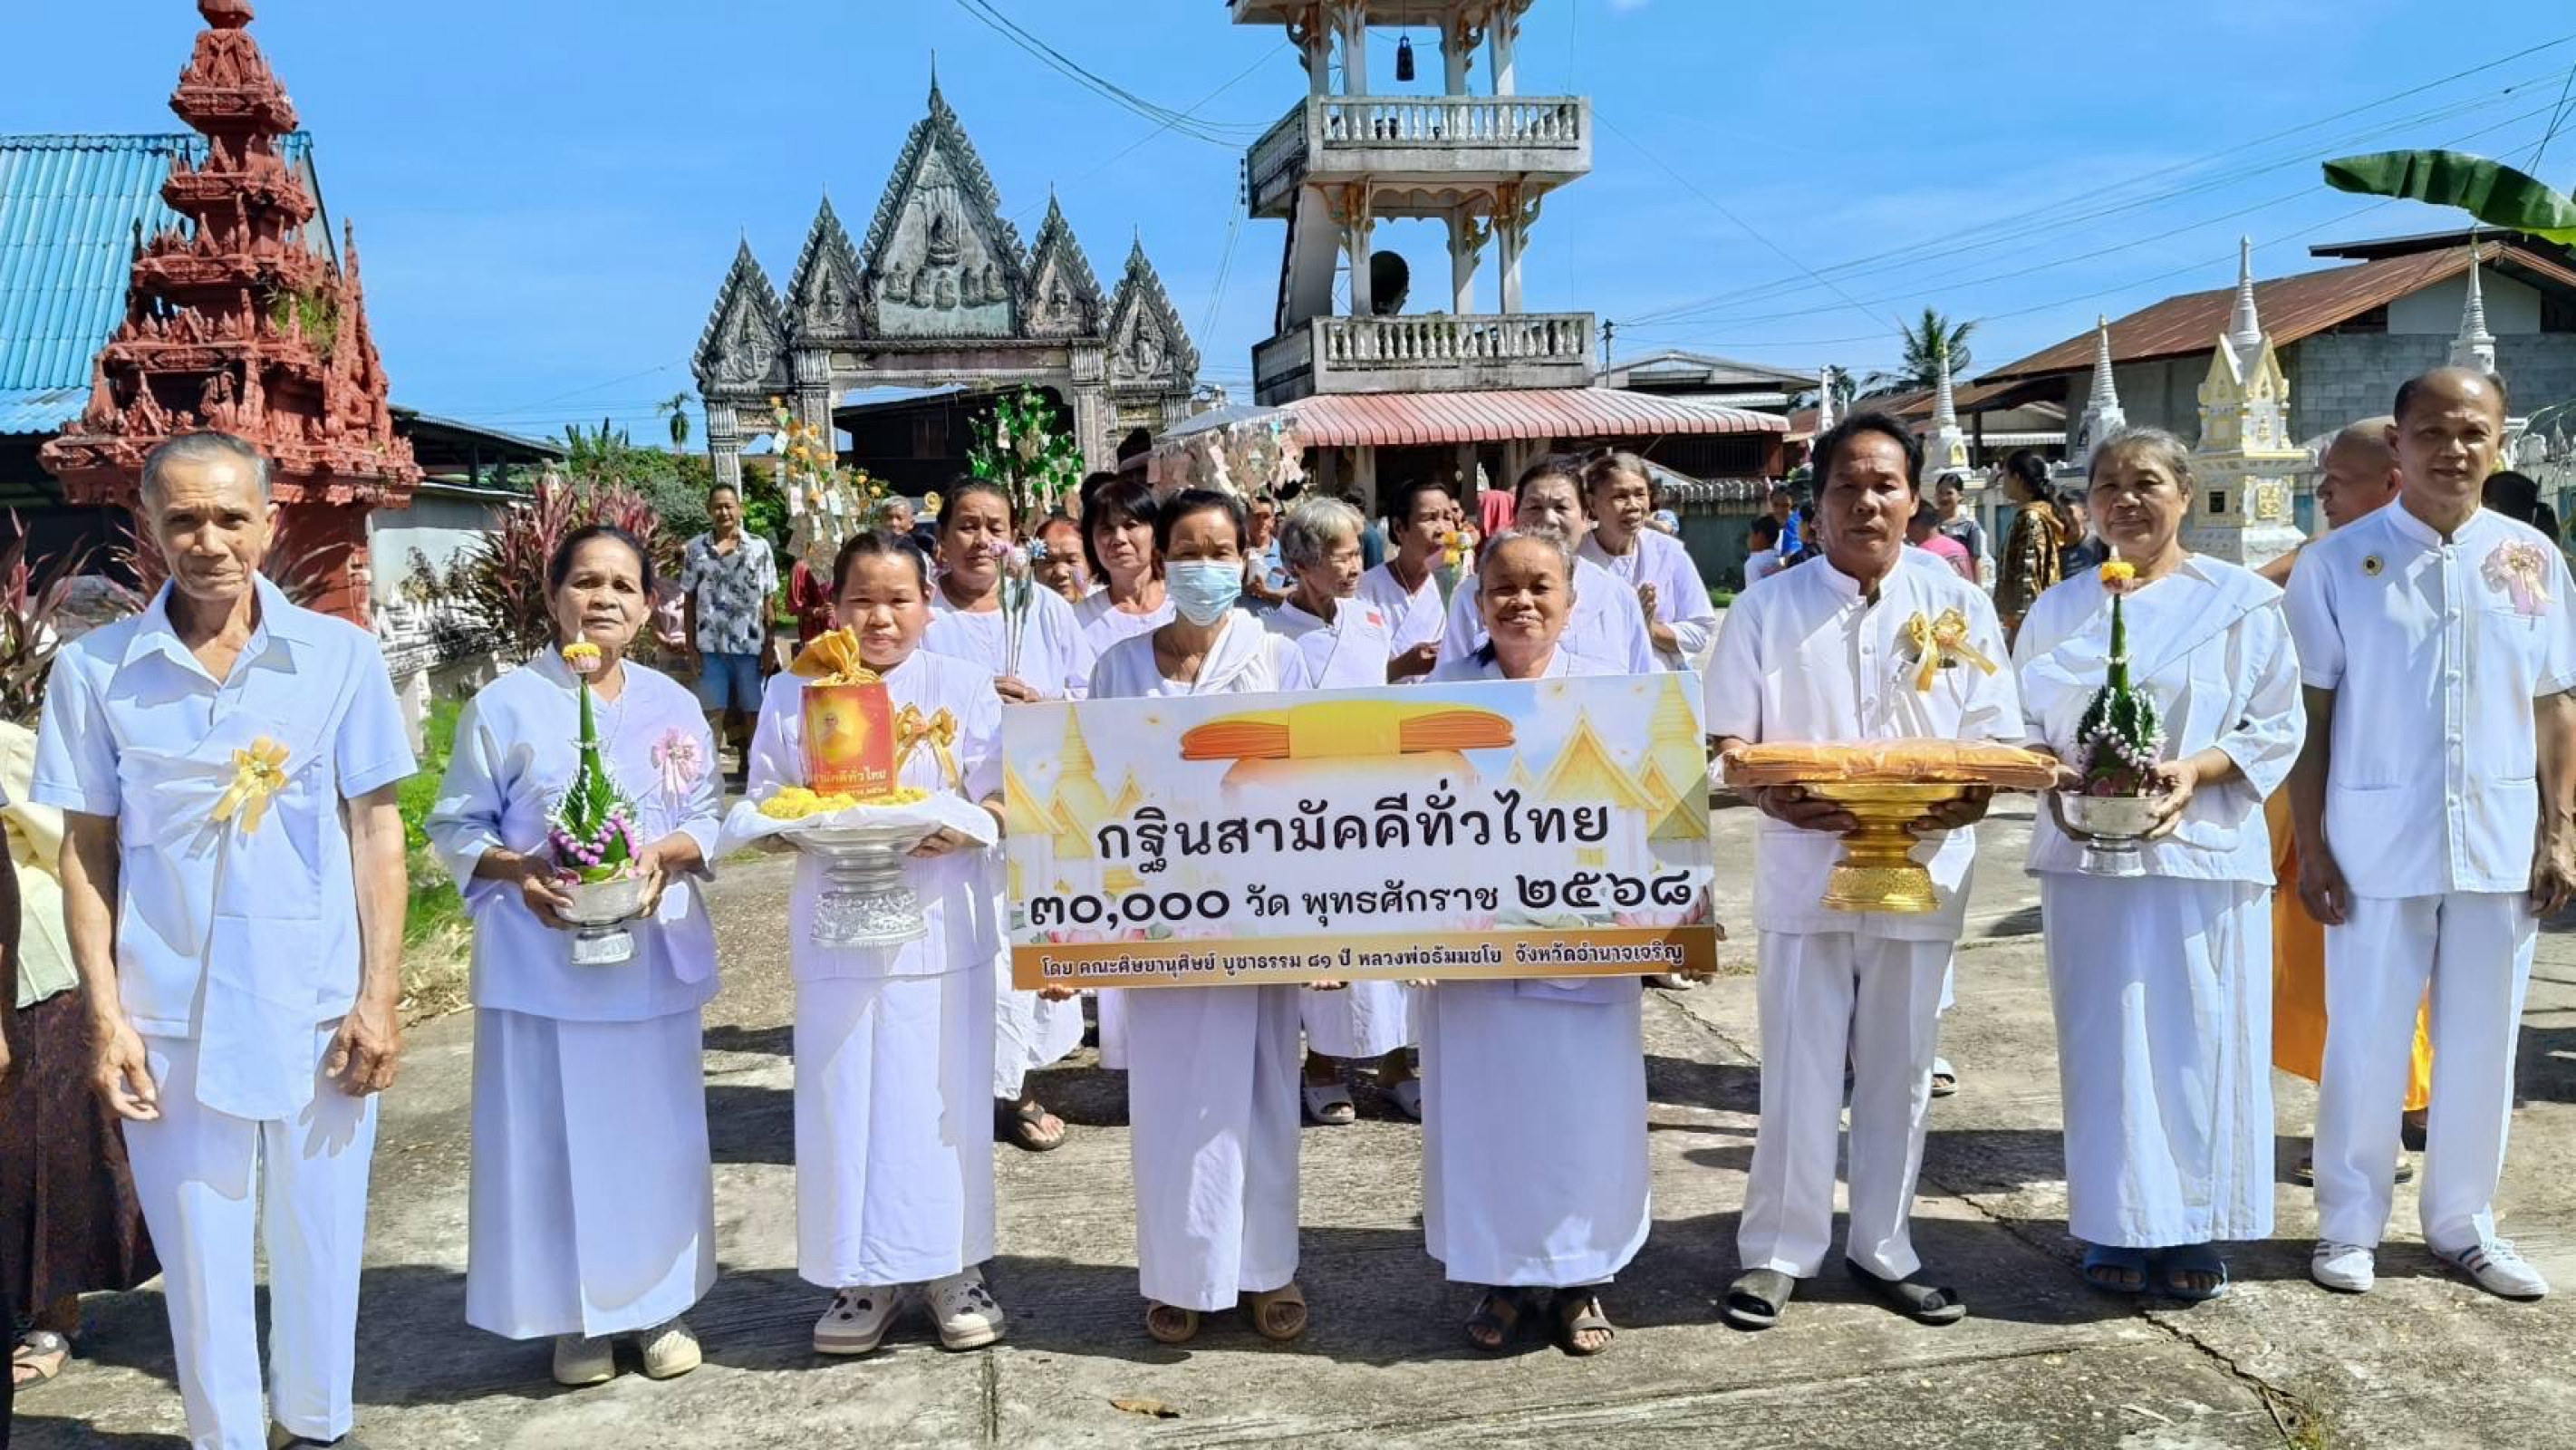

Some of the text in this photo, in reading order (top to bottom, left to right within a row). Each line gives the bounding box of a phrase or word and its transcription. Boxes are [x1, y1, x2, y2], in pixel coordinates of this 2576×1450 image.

[1097, 778, 1607, 874] กฐินสามัคคีทั่วไทย
[1030, 869, 1693, 930] ๓๐,๐๐๐ วัด พุทธศักราช ๒๕๖๘
[1042, 940, 1684, 978] โดย คณะศิษยานุศิษย์ บูชาธรรม ๘๑ ปี หลวงพ่อธัมมชโย จังหวัดอำนาจเจริญ
